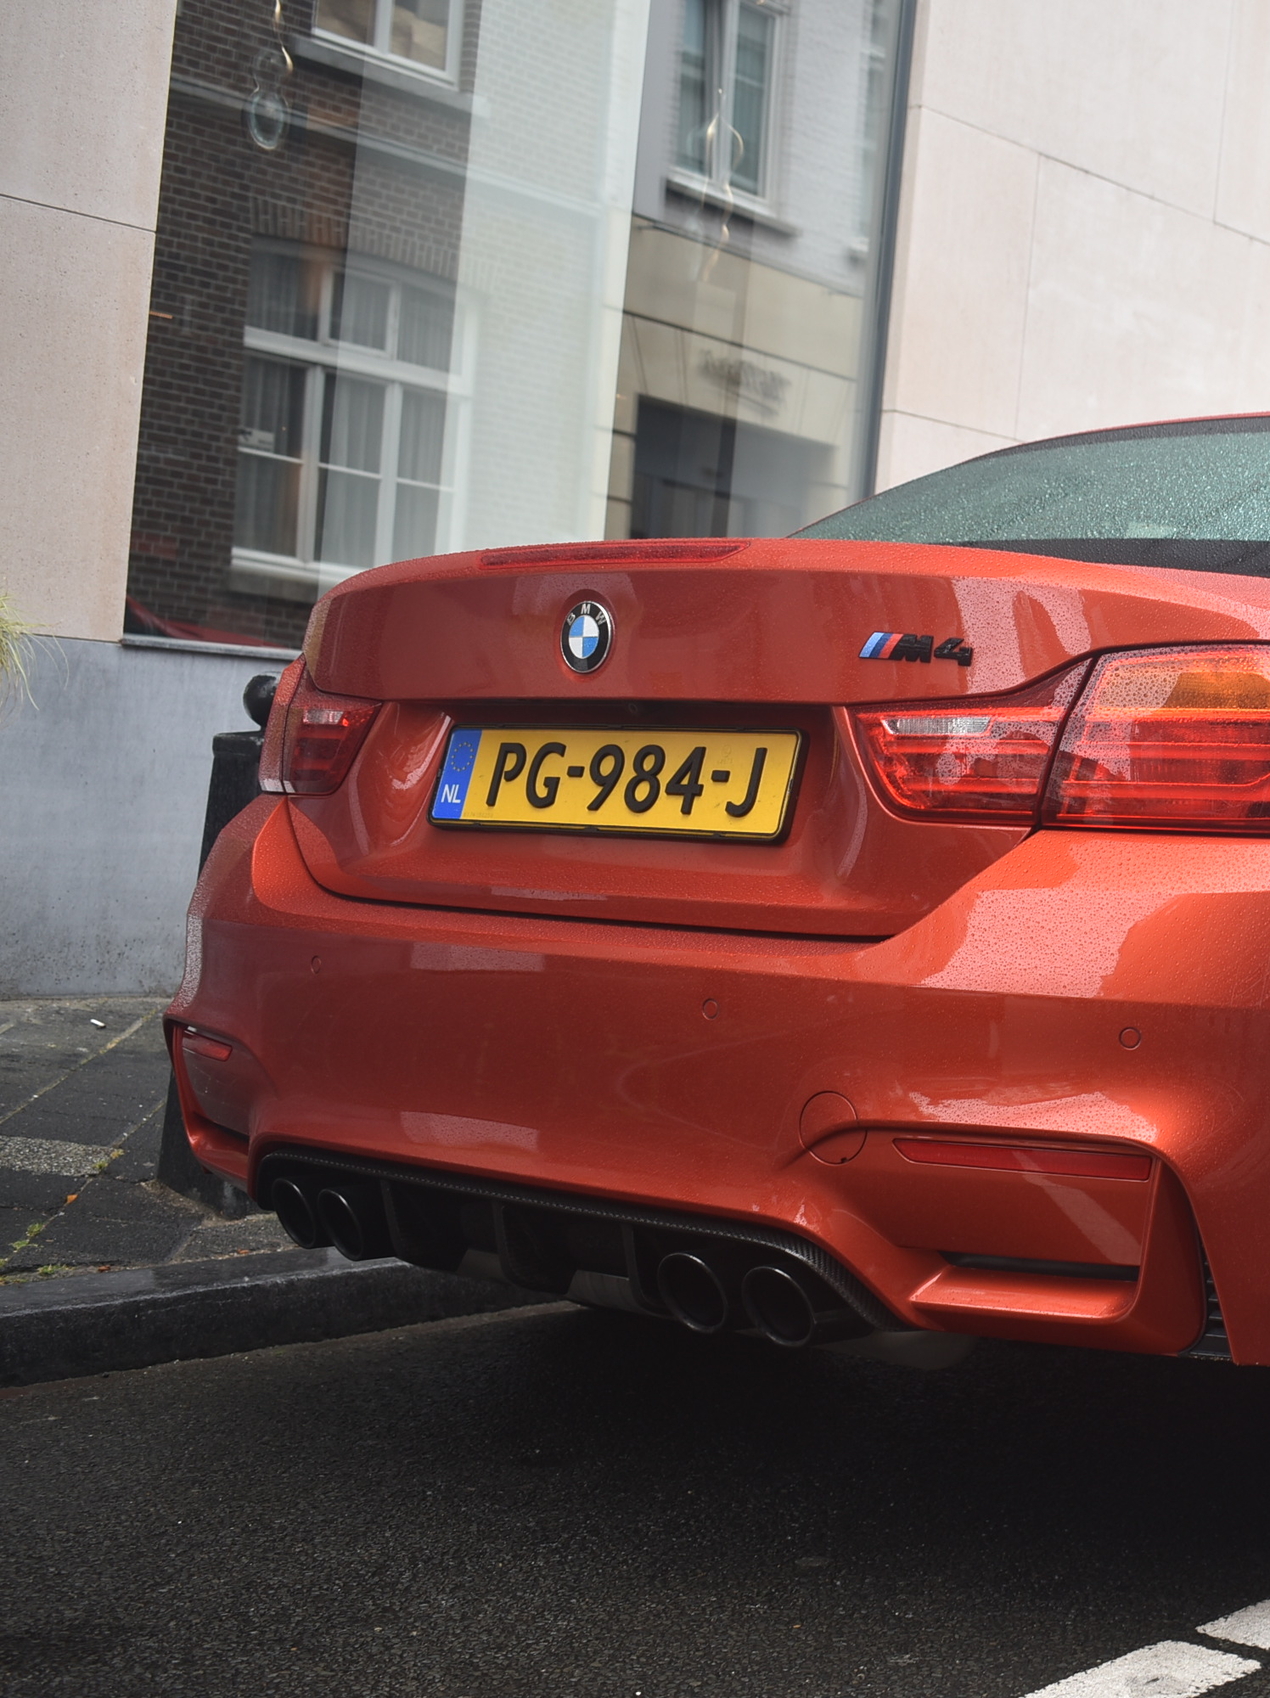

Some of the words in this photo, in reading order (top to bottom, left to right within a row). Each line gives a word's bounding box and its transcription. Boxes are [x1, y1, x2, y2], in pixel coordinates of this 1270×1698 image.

[567, 603, 607, 626] BMW
[888, 633, 973, 667] M4
[441, 784, 461, 803] NL
[486, 742, 768, 818] PG-984-J
